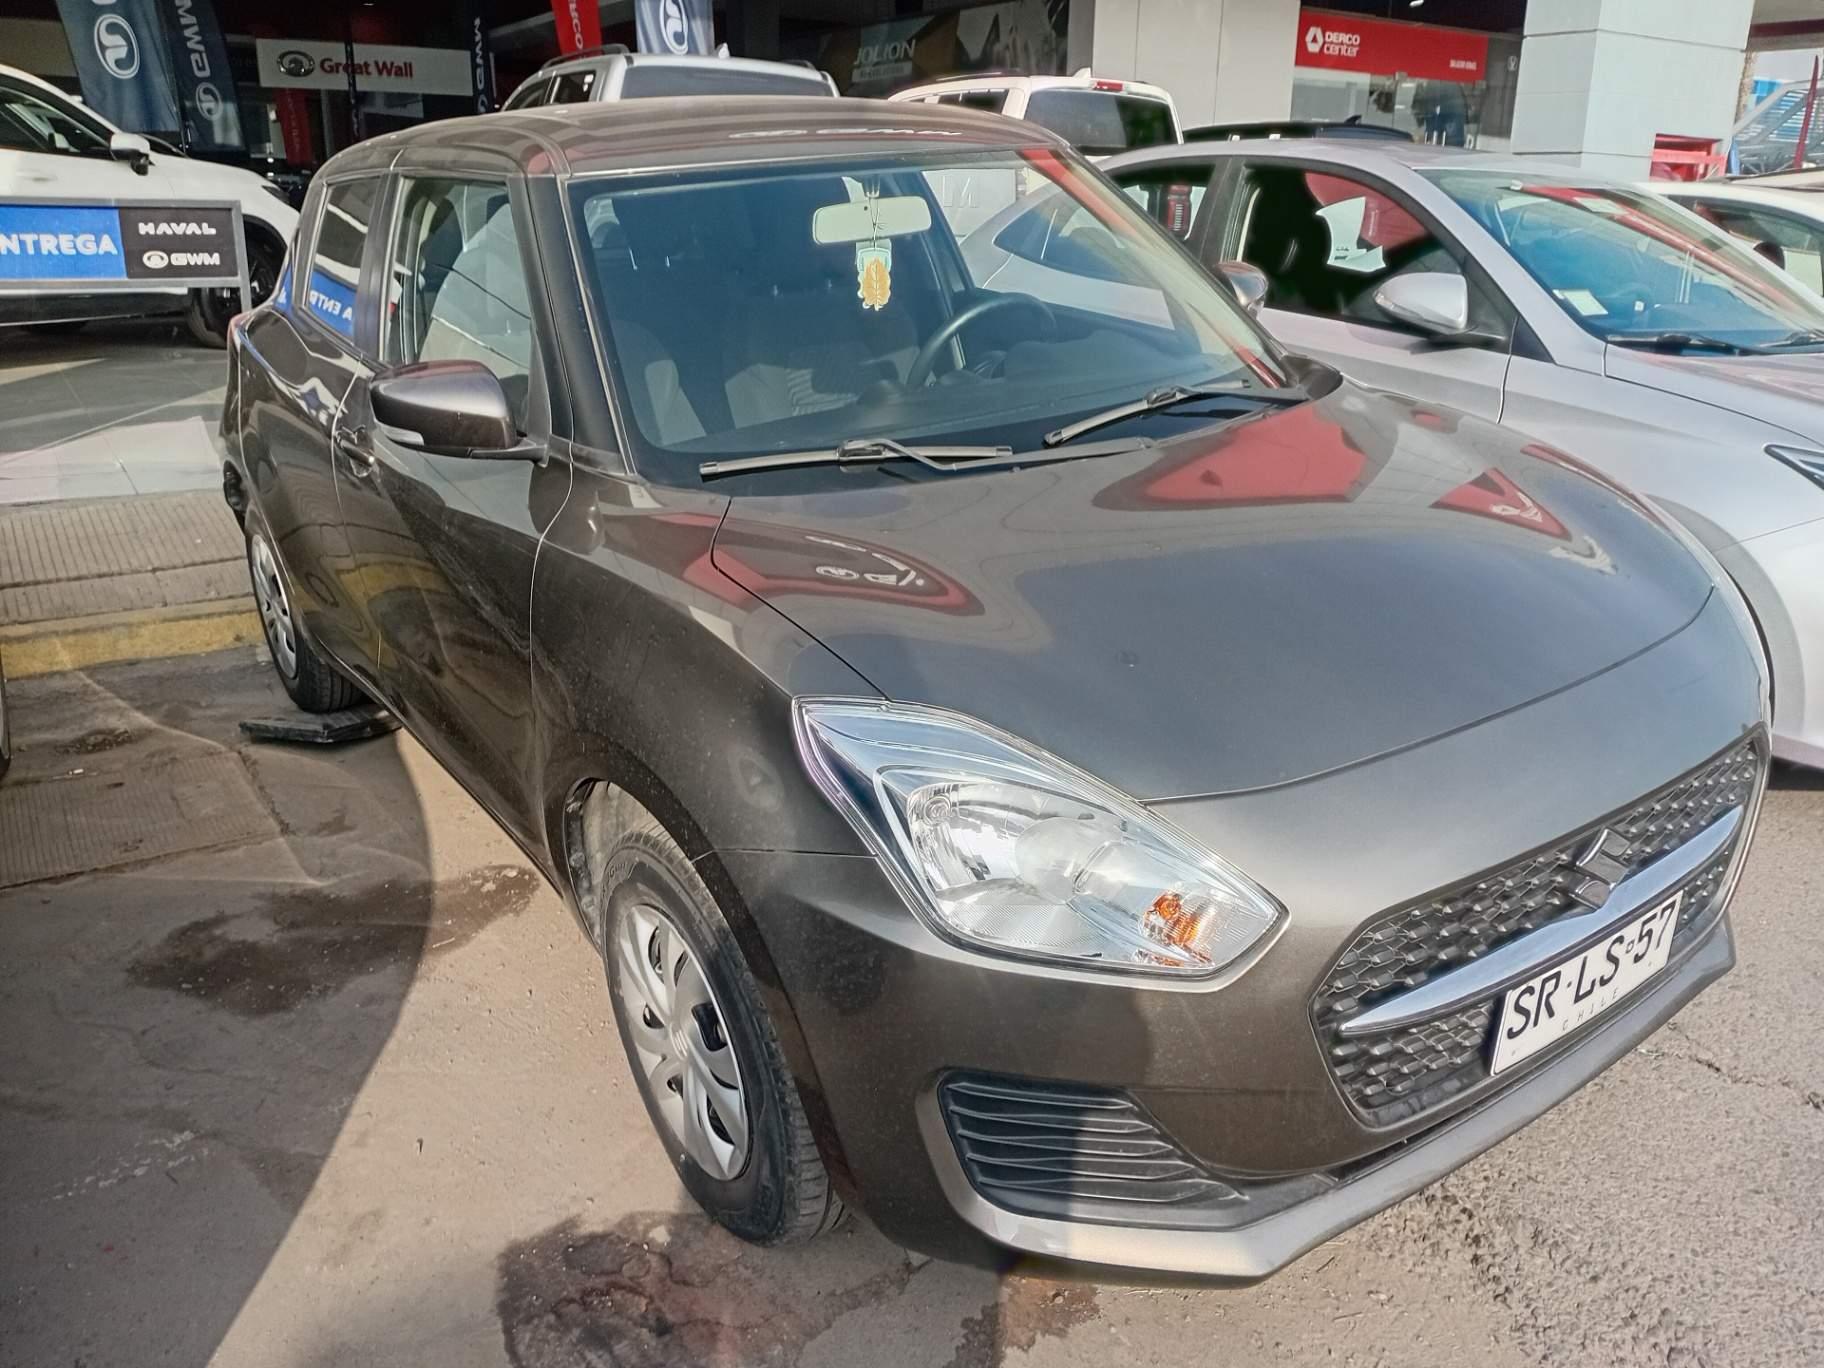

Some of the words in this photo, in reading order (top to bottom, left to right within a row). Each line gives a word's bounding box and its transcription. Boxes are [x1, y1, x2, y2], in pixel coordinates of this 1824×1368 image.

[1325, 31, 1360, 46] DERCO
[853, 39, 917, 65] JOLION
[1323, 43, 1359, 57] center
[374, 60, 413, 79] Wall
[138, 222, 216, 236] HAVAL
[170, 252, 220, 266] GWM
